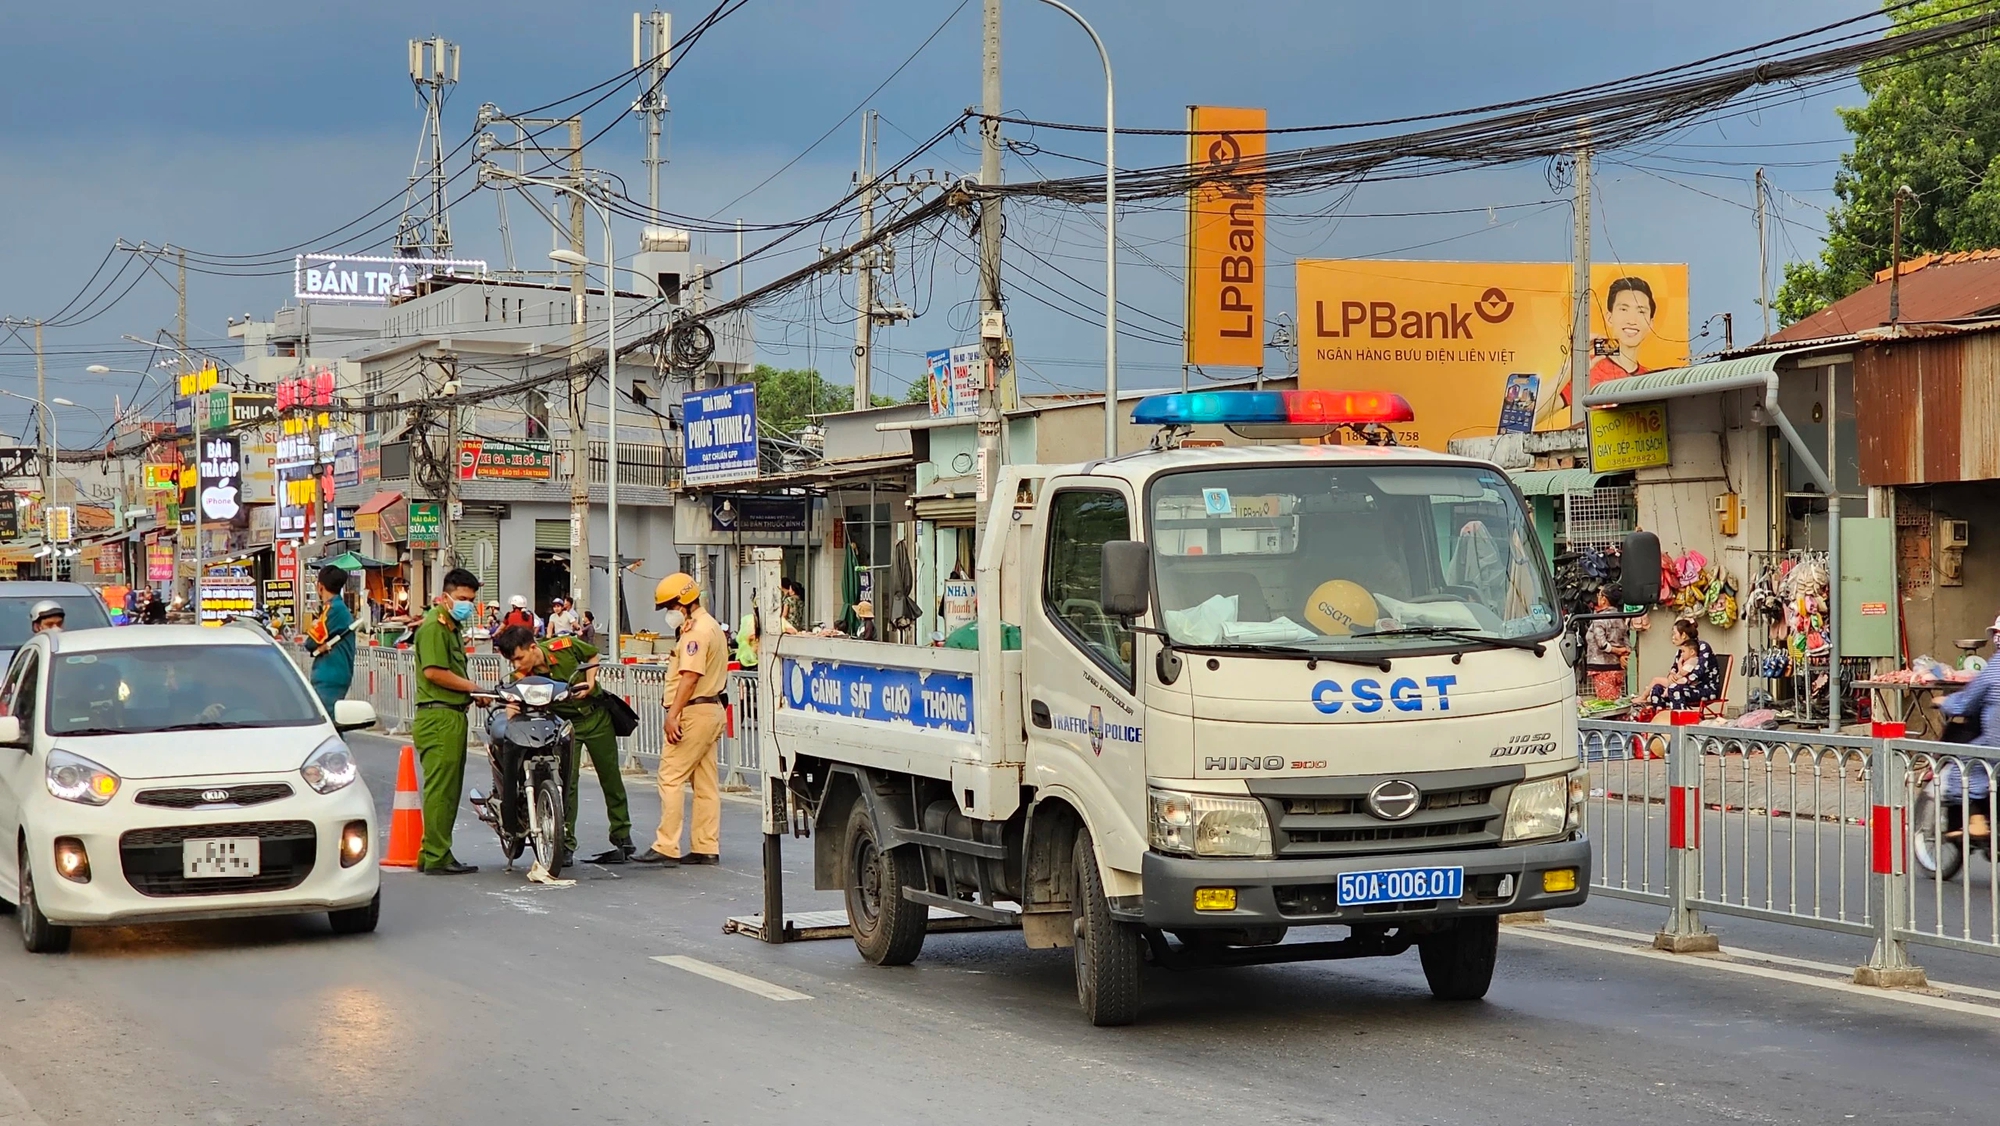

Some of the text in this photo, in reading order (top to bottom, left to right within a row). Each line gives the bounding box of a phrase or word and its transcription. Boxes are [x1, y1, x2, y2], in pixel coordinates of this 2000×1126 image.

[1220, 180, 1254, 338] LPBan
[306, 262, 358, 294] BÁN
[1316, 300, 1473, 340] LPBank
[1317, 346, 1516, 366] NGÂN HÀNG BƯU ĐIỆN LIÊN VIỆT
[702, 391, 732, 412] NHÀ THUỐC
[234, 406, 259, 420] THU
[688, 414, 752, 449] PHÚC THỊNH 2
[1595, 410, 1661, 438] Shop Phê
[207, 438, 231, 458] BÁN
[1597, 441, 1612, 458] GIÀY
[1617, 440, 1631, 455] DÉP
[1635, 438, 1646, 453] TÚI
[1646, 436, 1663, 452] SÁCH
[201, 458, 219, 478] TRẢ
[220, 458, 239, 478] GÓP
[480, 454, 491, 464] XE
[492, 454, 505, 464] GA
[512, 455, 522, 465] XE
[524, 452, 535, 465] SỐ
[206, 497, 231, 505] iPhone
[410, 523, 427, 533] SỬA
[947, 582, 968, 597] NHÀ
[1318, 601, 1352, 630] CSGT
[811, 668, 841, 706] CẢNH
[850, 676, 872, 710] SÁT
[921, 686, 967, 721] THÔNG
[1311, 674, 1457, 714] CSGT
[1053, 714, 1142, 743] TRAFFIC POLICE
[1489, 742, 1556, 758] DUTRO
[1204, 755, 1327, 770] HINO 300
[206, 791, 225, 800] KIA
